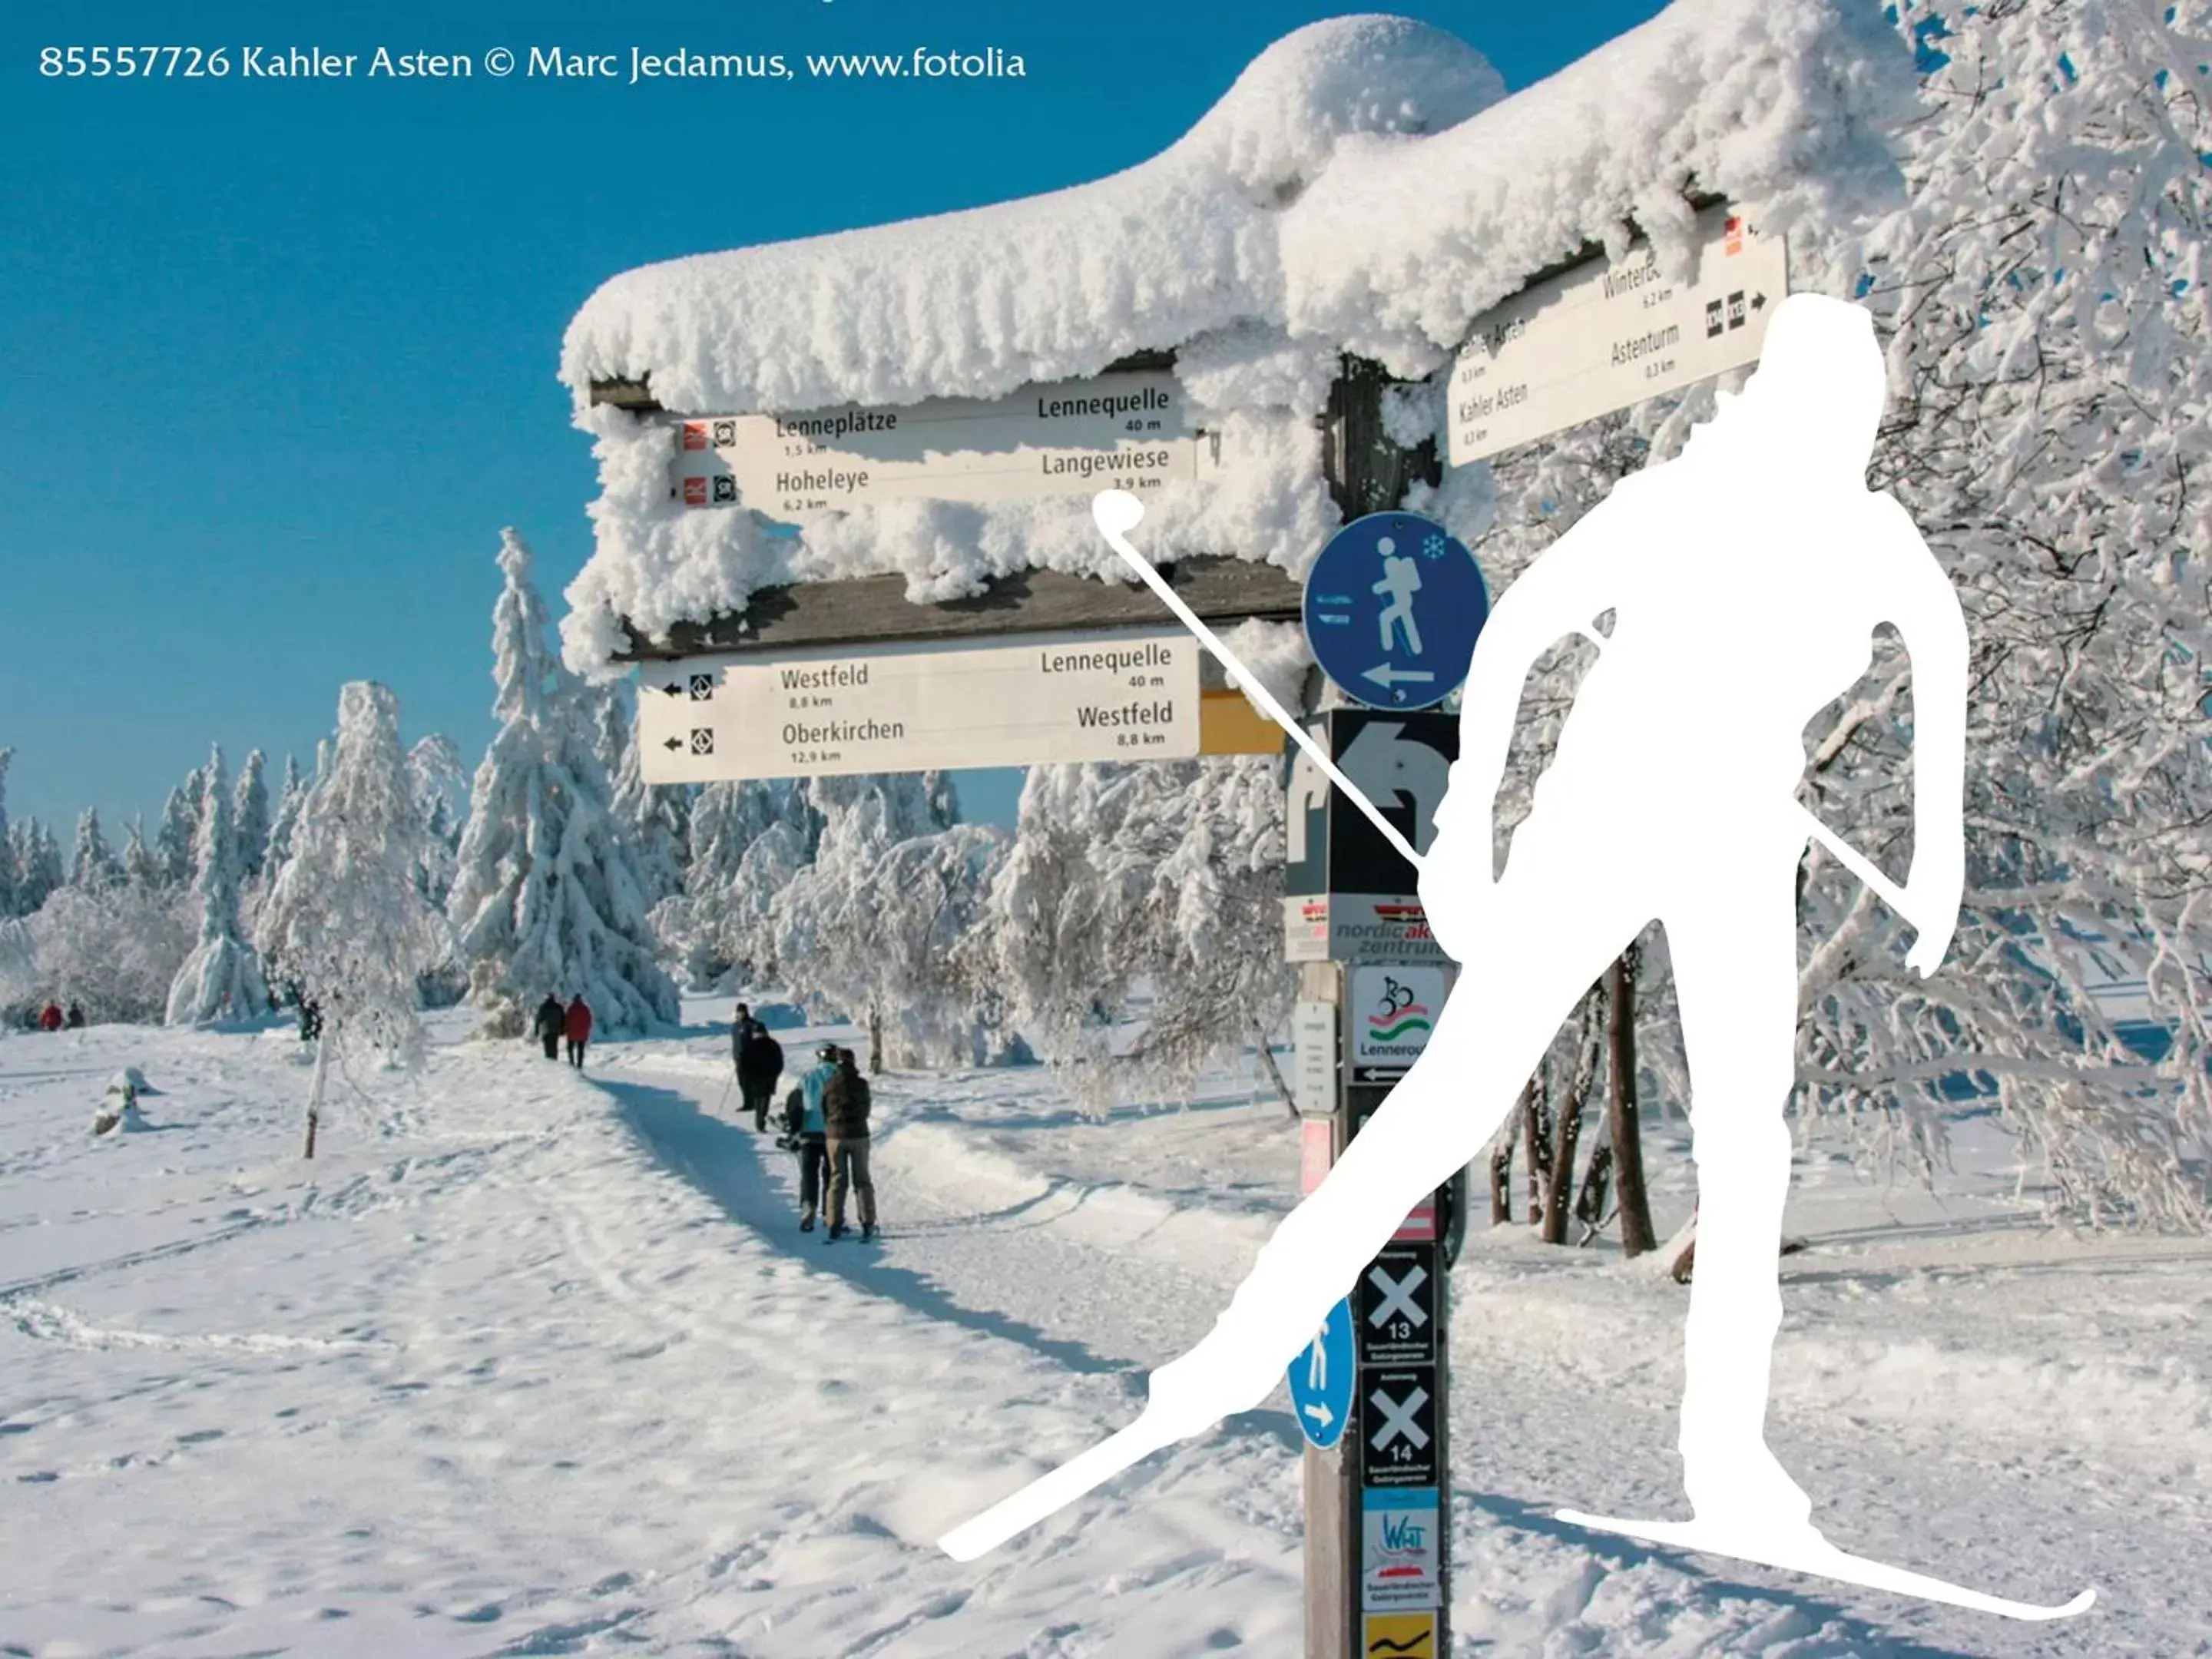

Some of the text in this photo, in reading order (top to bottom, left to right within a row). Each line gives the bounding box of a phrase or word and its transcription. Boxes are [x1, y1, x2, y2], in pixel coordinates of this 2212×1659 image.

[1612, 324, 1679, 367] Astenturm
[1038, 388, 1169, 419] Lennequelle
[1460, 384, 1528, 424] Kahler Asten
[776, 411, 897, 439] Lenneplätze
[1125, 419, 1161, 431] 40 m
[785, 443, 827, 457] 1,5 km
[1042, 448, 1169, 478] Langewiese
[776, 469, 869, 494] Hoheleye
[1139, 475, 1161, 488] km
[783, 498, 827, 512] 6,2 km
[1042, 644, 1171, 674] Lennequelle
[781, 664, 868, 690] Westfeld
[1128, 675, 1164, 687] 40 m
[813, 695, 832, 707] km
[1078, 700, 1173, 727] Westfeld
[783, 718, 904, 744] Oberkirchen
[1117, 733, 1165, 747] 8,8 km
[821, 750, 840, 762] km
[1389, 1322, 1411, 1339] 13
[1390, 1444, 1412, 1462] 14
